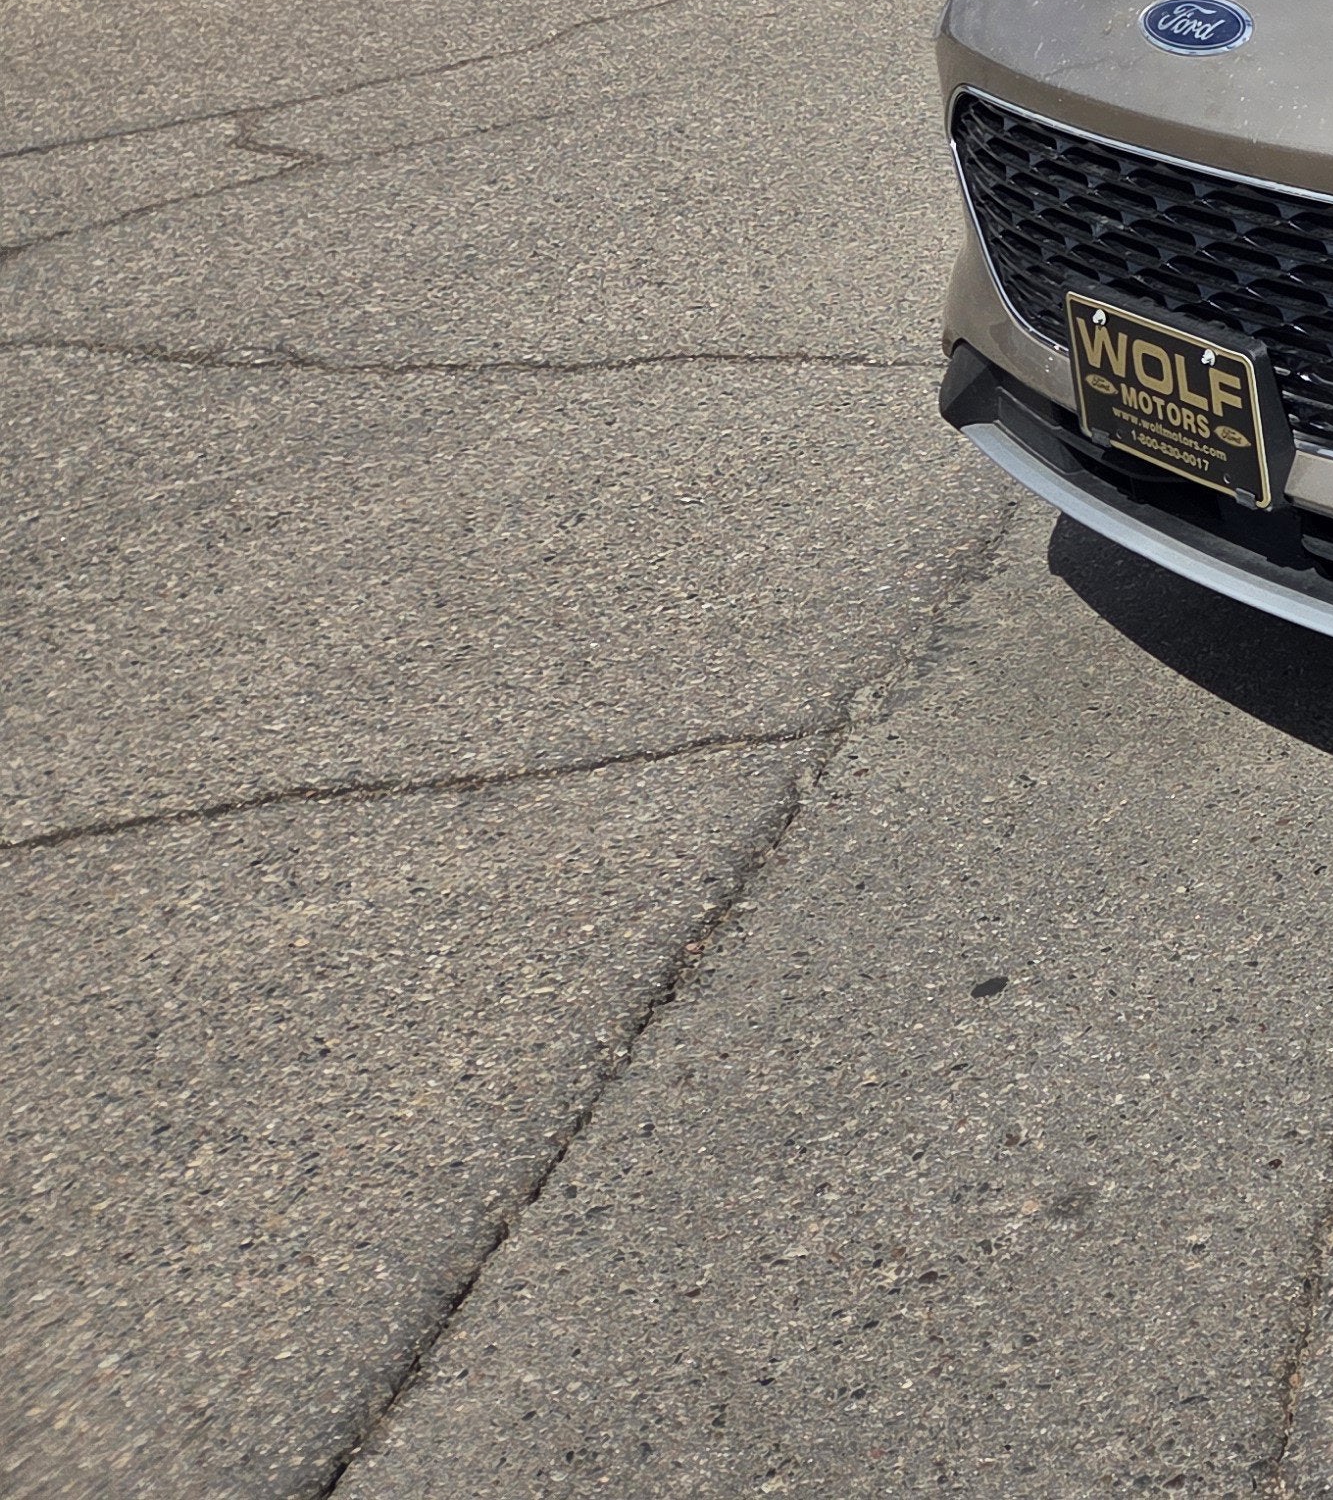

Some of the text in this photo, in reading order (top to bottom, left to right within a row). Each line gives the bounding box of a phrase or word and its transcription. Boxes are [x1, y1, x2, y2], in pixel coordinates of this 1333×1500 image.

[1158, 3, 1226, 41] Ford
[1076, 316, 1243, 417] WOLF
[1120, 383, 1211, 439] MOTORS
